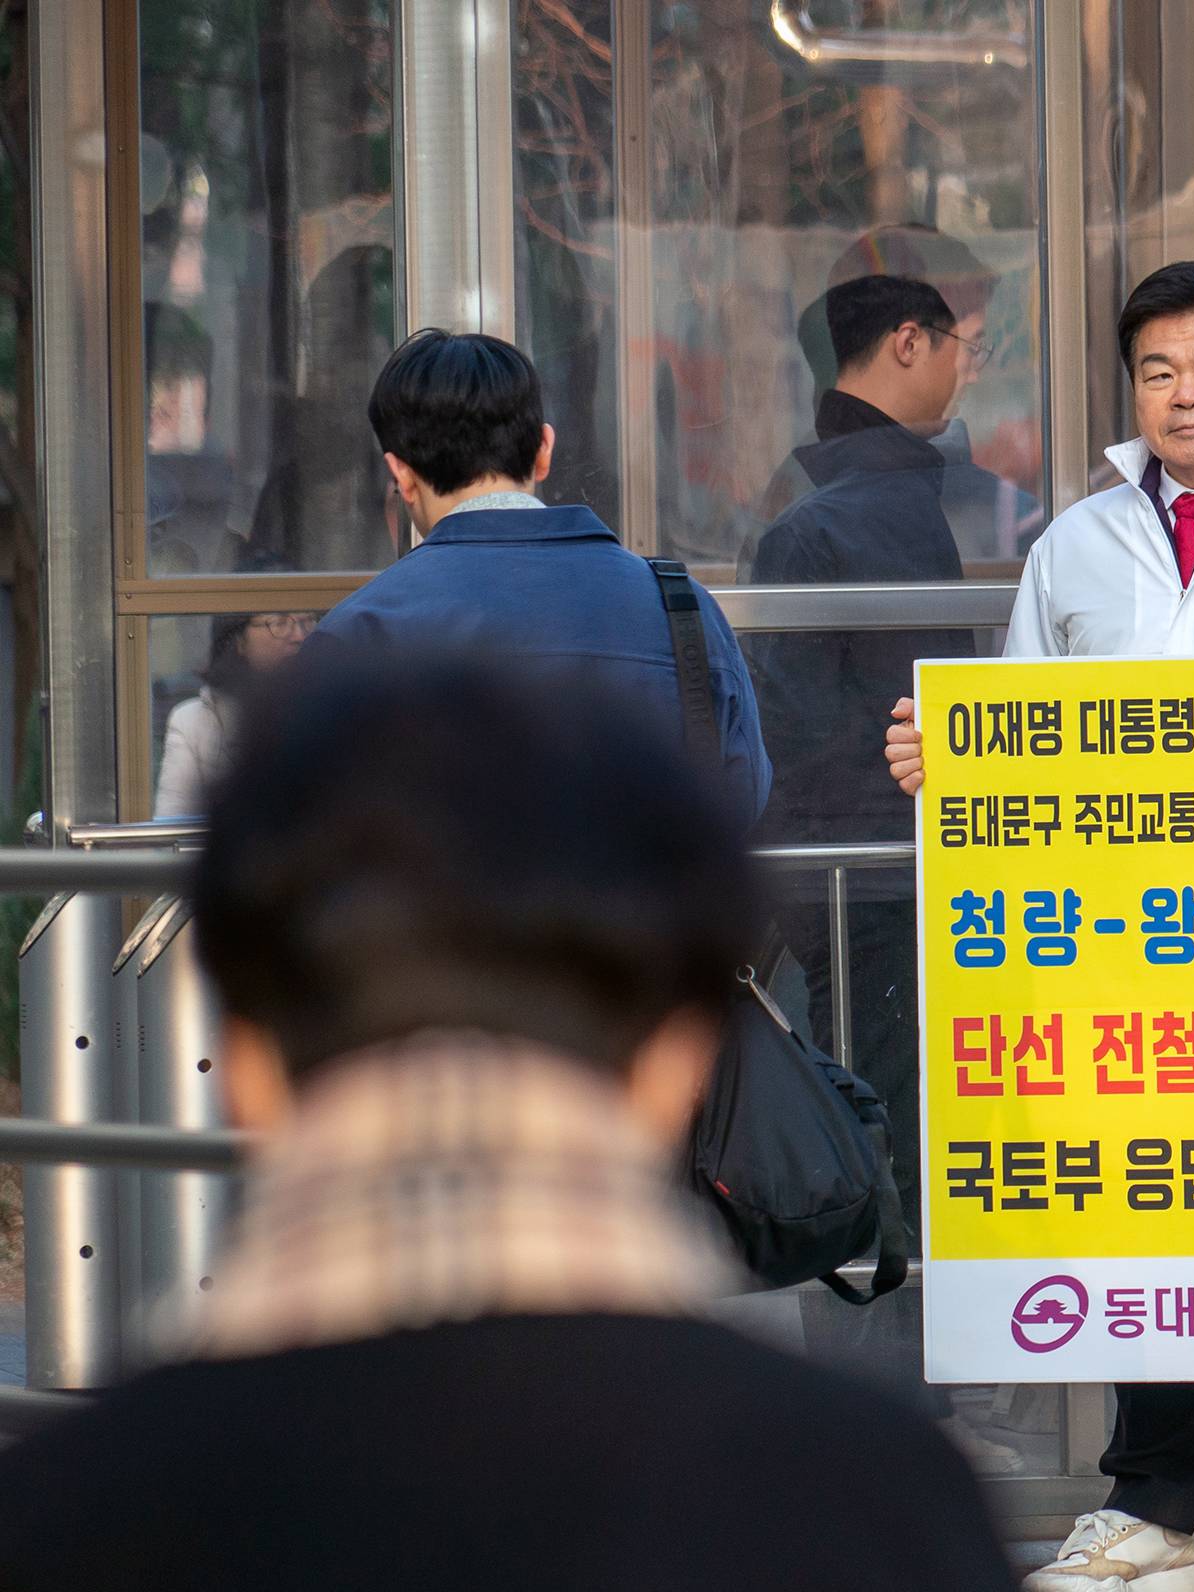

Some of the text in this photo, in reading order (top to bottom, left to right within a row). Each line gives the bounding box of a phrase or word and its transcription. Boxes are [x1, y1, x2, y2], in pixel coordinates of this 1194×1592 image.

[948, 700, 1063, 758] 이재명
[939, 795, 1062, 848] 동대문구
[952, 1013, 1065, 1097] 단선
[946, 1140, 1103, 1213] 국토부
